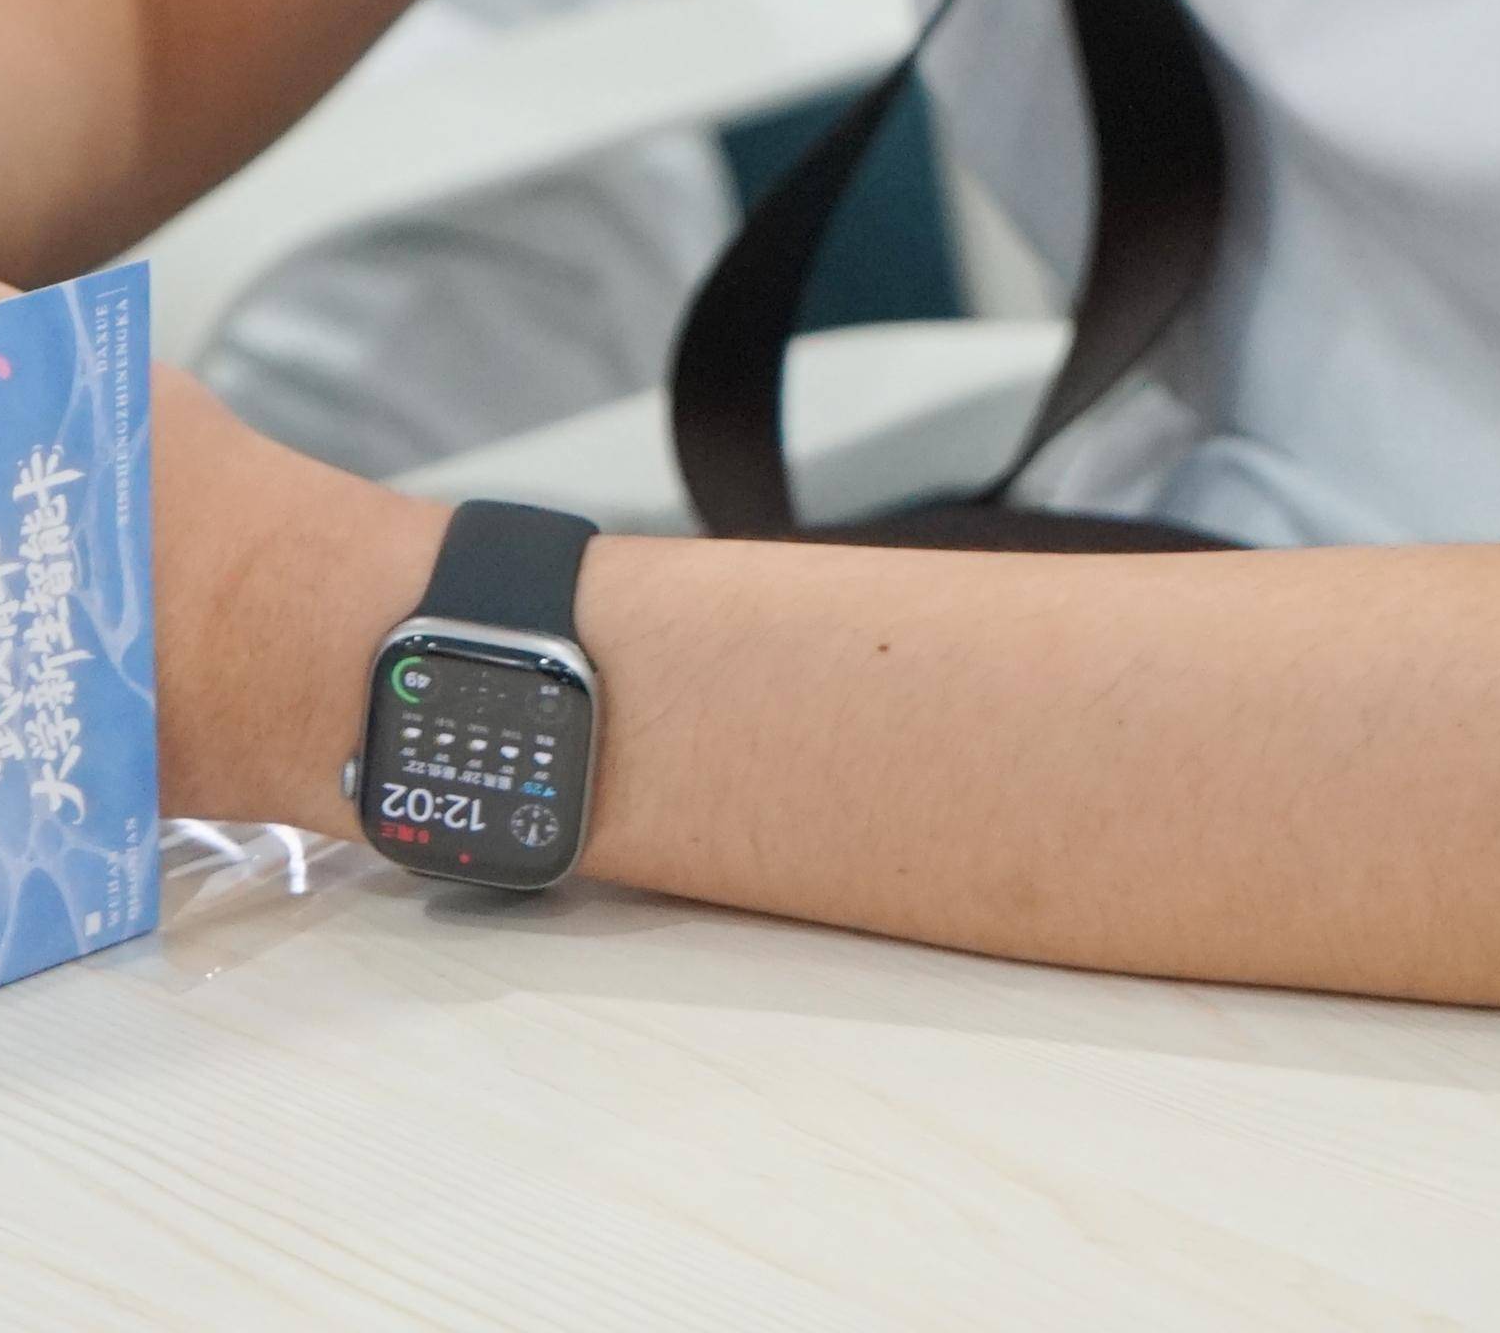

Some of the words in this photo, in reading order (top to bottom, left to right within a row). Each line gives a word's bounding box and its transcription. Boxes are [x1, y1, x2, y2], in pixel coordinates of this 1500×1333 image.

[12, 445, 95, 825] 大学新生智能卡
[381, 782, 487, 832] 12:02
